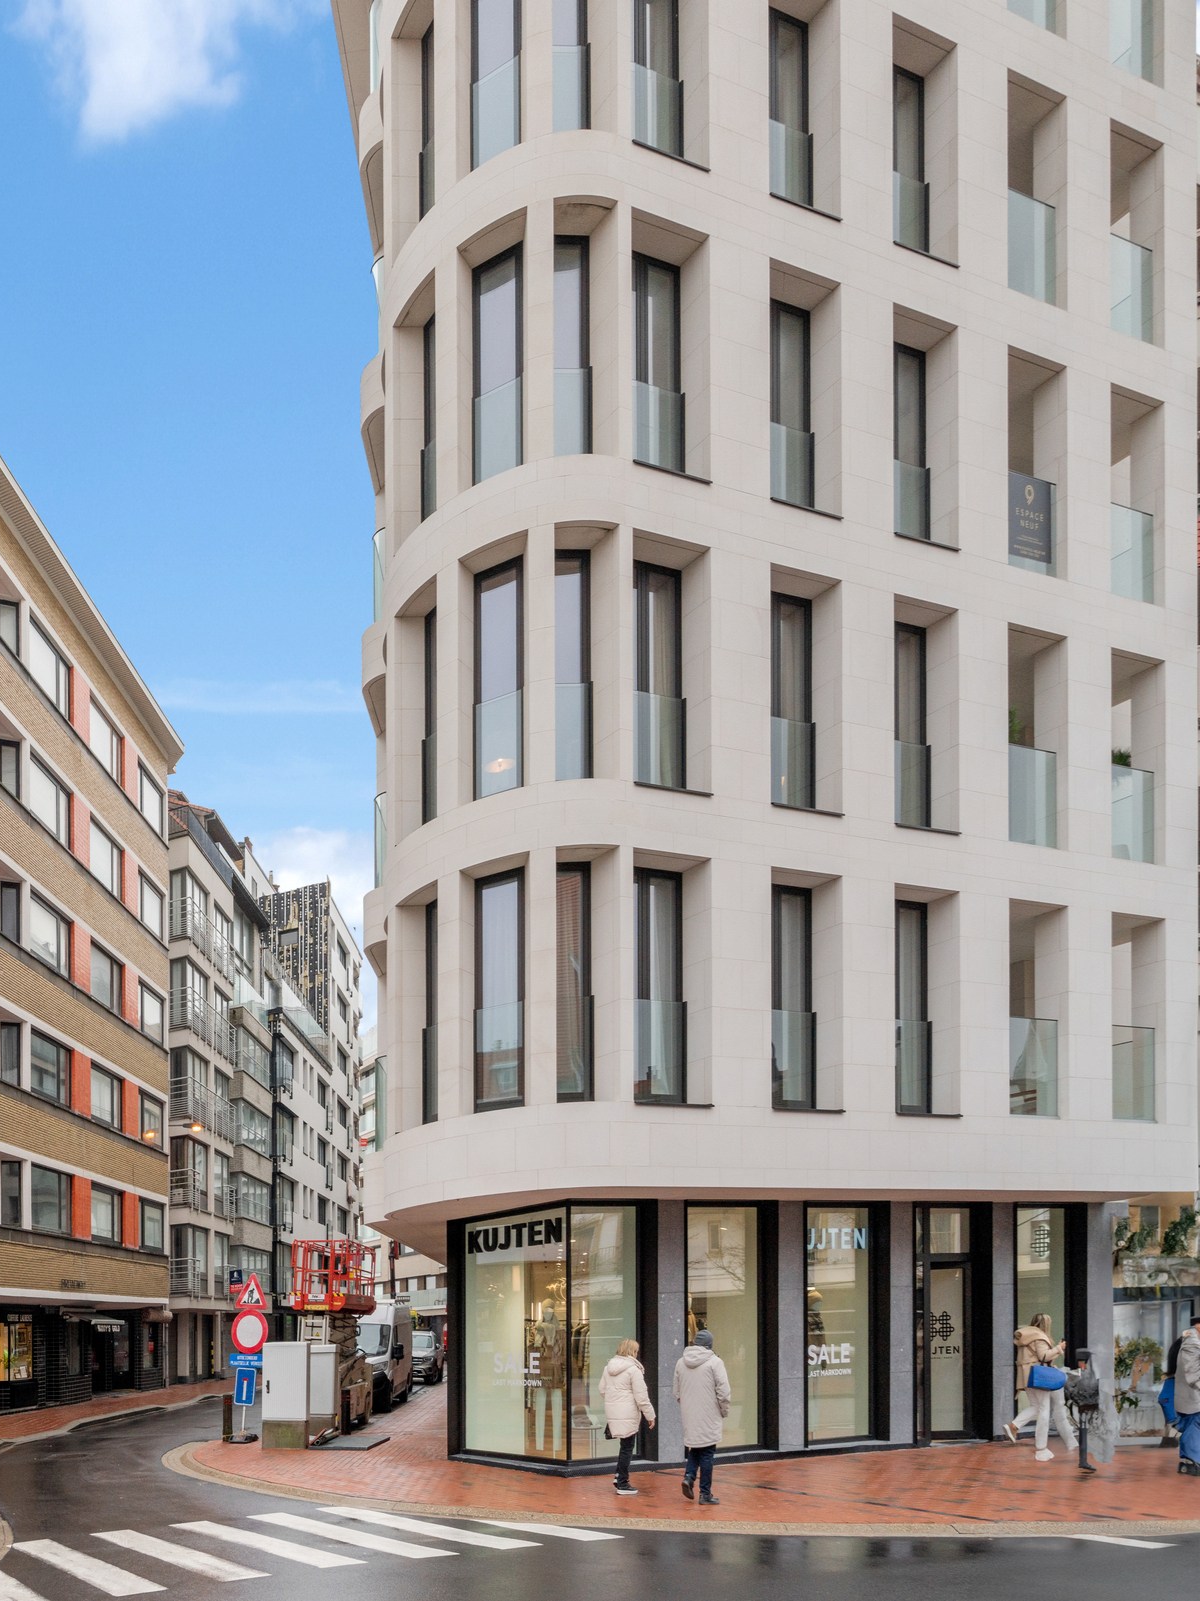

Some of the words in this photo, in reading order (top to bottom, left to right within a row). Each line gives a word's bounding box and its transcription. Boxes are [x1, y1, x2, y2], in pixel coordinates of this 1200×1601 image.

[1015, 507, 1045, 522] ESPACE
[1020, 519, 1040, 531] NEUF
[467, 1217, 563, 1254] KUJTEN
[493, 1352, 541, 1374] SALE
[808, 1343, 851, 1365] SALE
[820, 1368, 852, 1377] MARKDOWN
